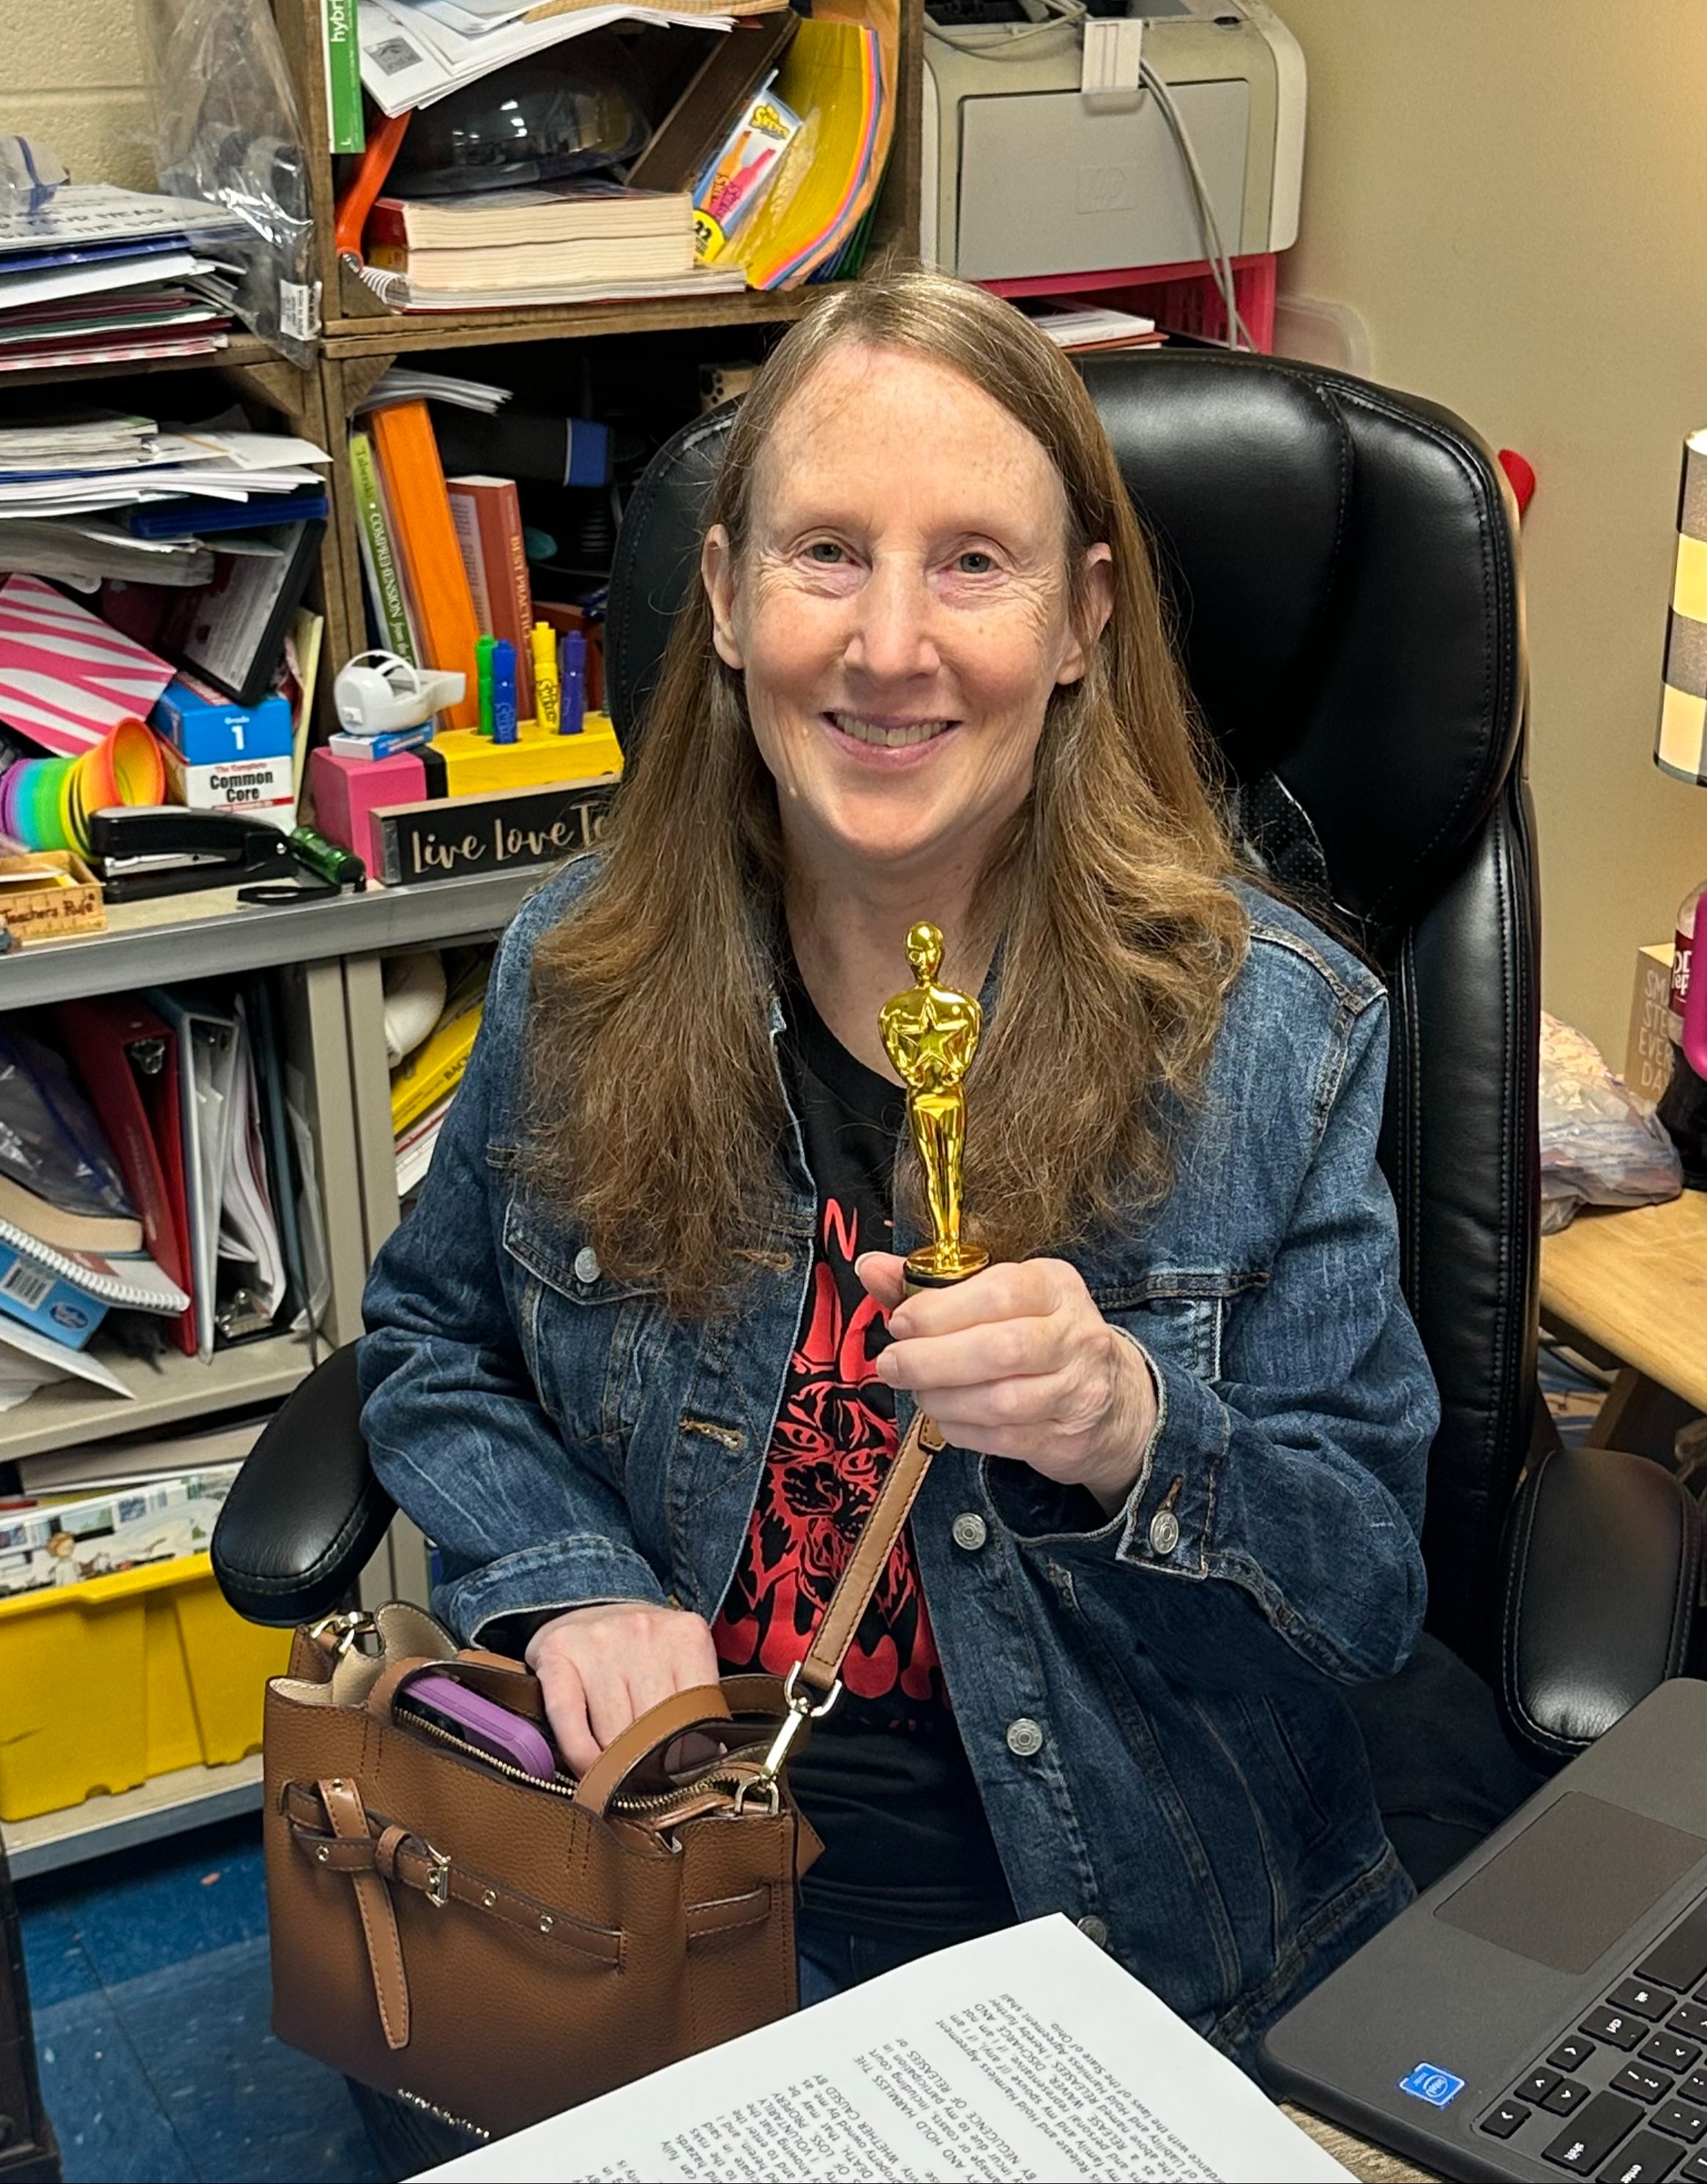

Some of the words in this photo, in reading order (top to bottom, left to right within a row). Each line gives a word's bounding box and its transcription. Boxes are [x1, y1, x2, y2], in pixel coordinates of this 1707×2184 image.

[370, 513, 403, 619] COMPREHENSION
[510, 536, 524, 576] BEST
[231, 725, 244, 750] 1
[210, 770, 274, 790] Common
[225, 788, 260, 802] Core
[974, 2003, 997, 2021] AND
[987, 1999, 1020, 2027] further
[998, 1993, 1024, 2013] shall
[949, 2013, 966, 2028] am
[961, 2008, 980, 2024] not
[935, 2019, 982, 2062] Agreement
[965, 2034, 979, 2042] if
[978, 2024, 996, 2038] am
[1016, 2025, 1048, 2055] hereby
[1021, 2012, 1069, 2056] Agreement
[882, 2043, 894, 2053] in
[895, 2038, 909, 2048] or
[995, 2044, 1009, 2053] if
[996, 2024, 1047, 2072] DISCHARGE
[1067, 2043, 1085, 2053] of
[854, 2054, 874, 2075] THE
[867, 2048, 893, 2071] court
[1081, 2052, 1107, 2076] State
[812, 2073, 829, 2087] BY
[892, 2054, 946, 2106] participation
[905, 2050, 952, 2094] RELEASEES
[978, 2062, 1020, 2102] Harmless
[1067, 2056, 1109, 2095] Harmless
[1103, 2073, 1121, 2090] the
[787, 2084, 802, 2098] be
[801, 2079, 815, 2090] as
[890, 2071, 930, 2112] including
[1010, 2074, 1044, 2106] spouse
[1115, 2089, 1132, 2099] of
[825, 2086, 861, 2121] CAUSED
[871, 2074, 918, 2120] HARMLESS
[949, 2096, 968, 2109] OF
[1104, 2094, 1131, 2117] Hold
[731, 2109, 748, 2125] the
[745, 2102, 763, 2119] the
[770, 2092, 810, 2130] PROPERY
[800, 2100, 821, 2120] may
[826, 2107, 842, 2121] by
[942, 2106, 960, 2121] my
[1014, 2100, 1041, 2123] Hold
[1095, 2103, 1131, 2134] named
[1129, 2098, 1154, 2120] laws
[701, 2121, 723, 2141] said
[720, 2121, 742, 2139] and
[757, 2098, 813, 2157] VOLUNTARILY
[758, 2117, 780, 2139] that
[820, 2122, 841, 2142] that
[915, 2120, 944, 2147] HOLD
[957, 2121, 971, 2133] to
[1035, 2121, 1058, 2139] and
[1053, 2120, 1077, 2138] and
[1067, 2114, 1112, 2151] personal
[1126, 2115, 1151, 2133] and
[1150, 2118, 1170, 2134] the
[689, 2127, 711, 2150] risks
[744, 2126, 769, 2149] enter
[834, 2119, 867, 2150] owned
[856, 2120, 900, 2166] WHETHER
[965, 2111, 1020, 2166] NEGLIGENCE
[969, 2133, 990, 2152] due
[1166, 2133, 1189, 2154] with
[675, 2133, 708, 2170] hazards
[722, 2143, 734, 2154] in
[766, 2149, 780, 2161] to
[776, 2136, 813, 2177] knowing
[957, 2143, 972, 2154] or
[1055, 2139, 1091, 2174] Release
[1075, 2139, 1105, 2169] family
[1129, 2133, 1159, 2160] above
[1147, 2133, 1187, 2169] Liability
[709, 2151, 726, 2168] the
[941, 2148, 967, 2169] AND
[987, 2153, 1013, 2177] incur
[1105, 2152, 1129, 2170] and
[1129, 2153, 1140, 2161] a
[725, 2169, 738, 2182] to
[773, 2161, 796, 2180] and
[832, 2162, 851, 2176] OF
[1019, 2168, 1038, 2182] BY
[1140, 2164, 1157, 2177] as
[1157, 2160, 1176, 2177] the
[1180, 2169, 1198, 2180] of
